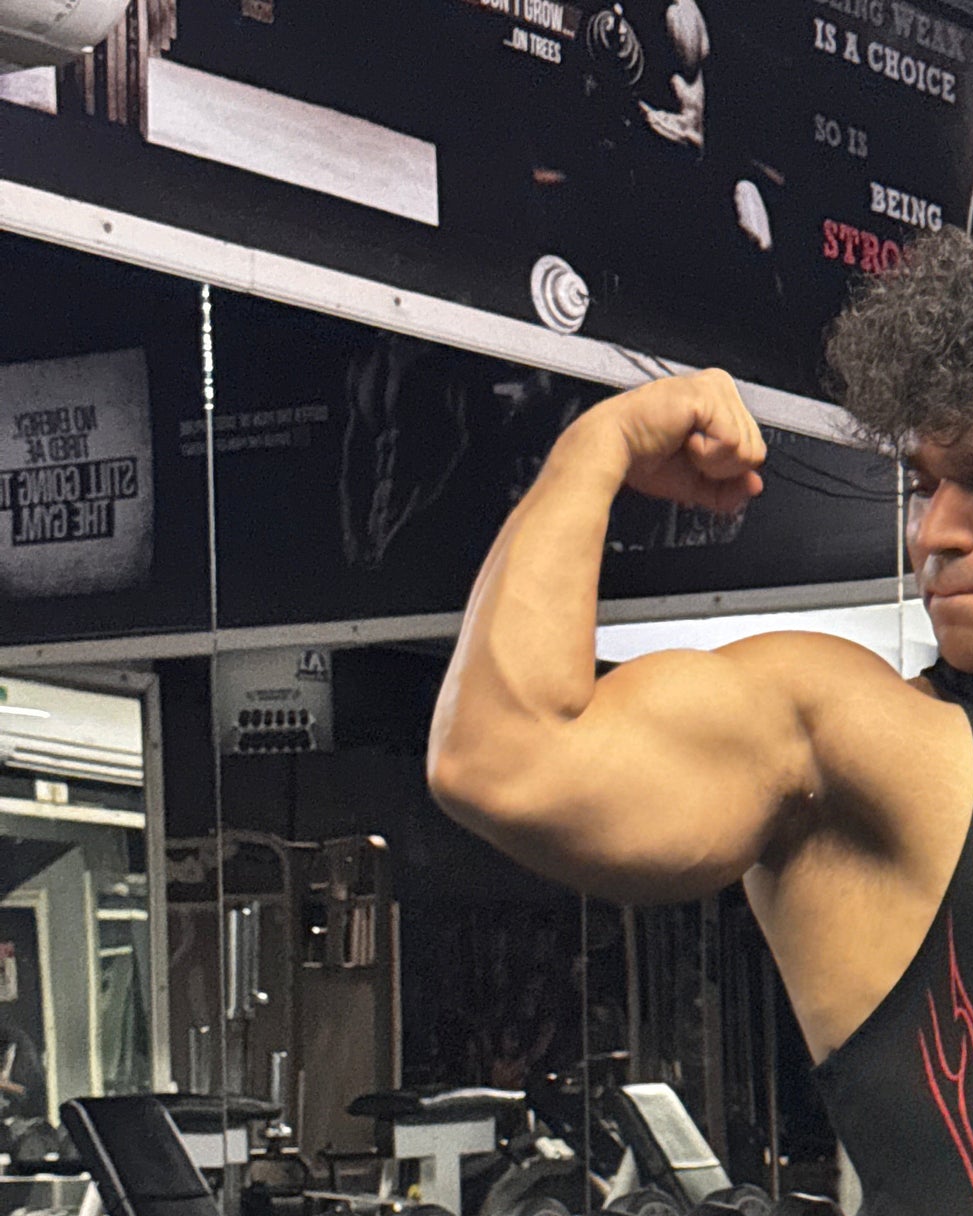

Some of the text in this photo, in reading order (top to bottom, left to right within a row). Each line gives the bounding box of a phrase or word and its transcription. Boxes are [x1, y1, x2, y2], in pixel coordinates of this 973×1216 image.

[530, 33, 561, 64] TREES
[891, 2, 966, 62] WEAK
[813, 18, 956, 104] IS A CHOICE
[814, 113, 868, 158] SO IS
[870, 181, 943, 232] BEING
[823, 218, 916, 274] STRO
